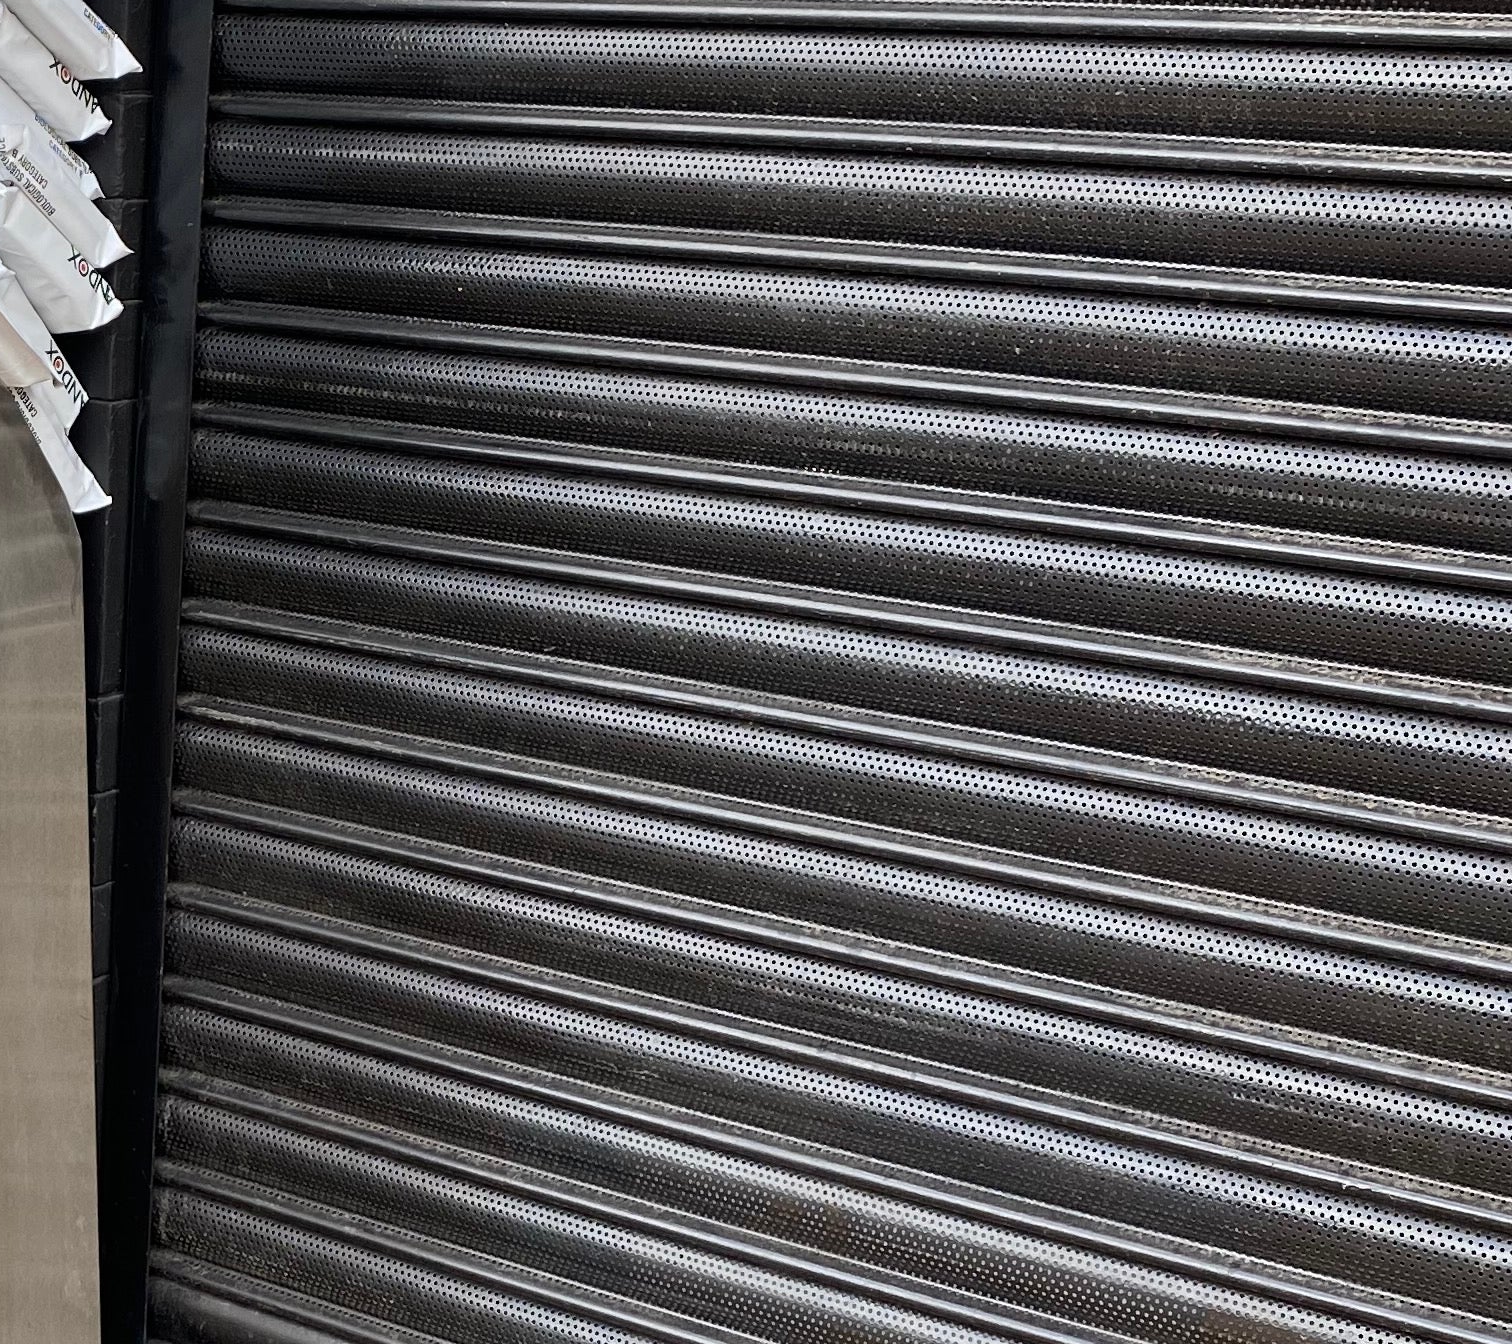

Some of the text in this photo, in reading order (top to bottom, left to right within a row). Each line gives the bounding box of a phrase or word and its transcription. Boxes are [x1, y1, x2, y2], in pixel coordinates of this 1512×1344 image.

[49, 55, 101, 114] ANDOX
[11, 148, 48, 189] CATEGORY B
[25, 180, 56, 216] BIOLOGICAL
[67, 245, 116, 306] ANDOX
[45, 339, 88, 408] ANDOX
[14, 386, 39, 417] CATEGO
